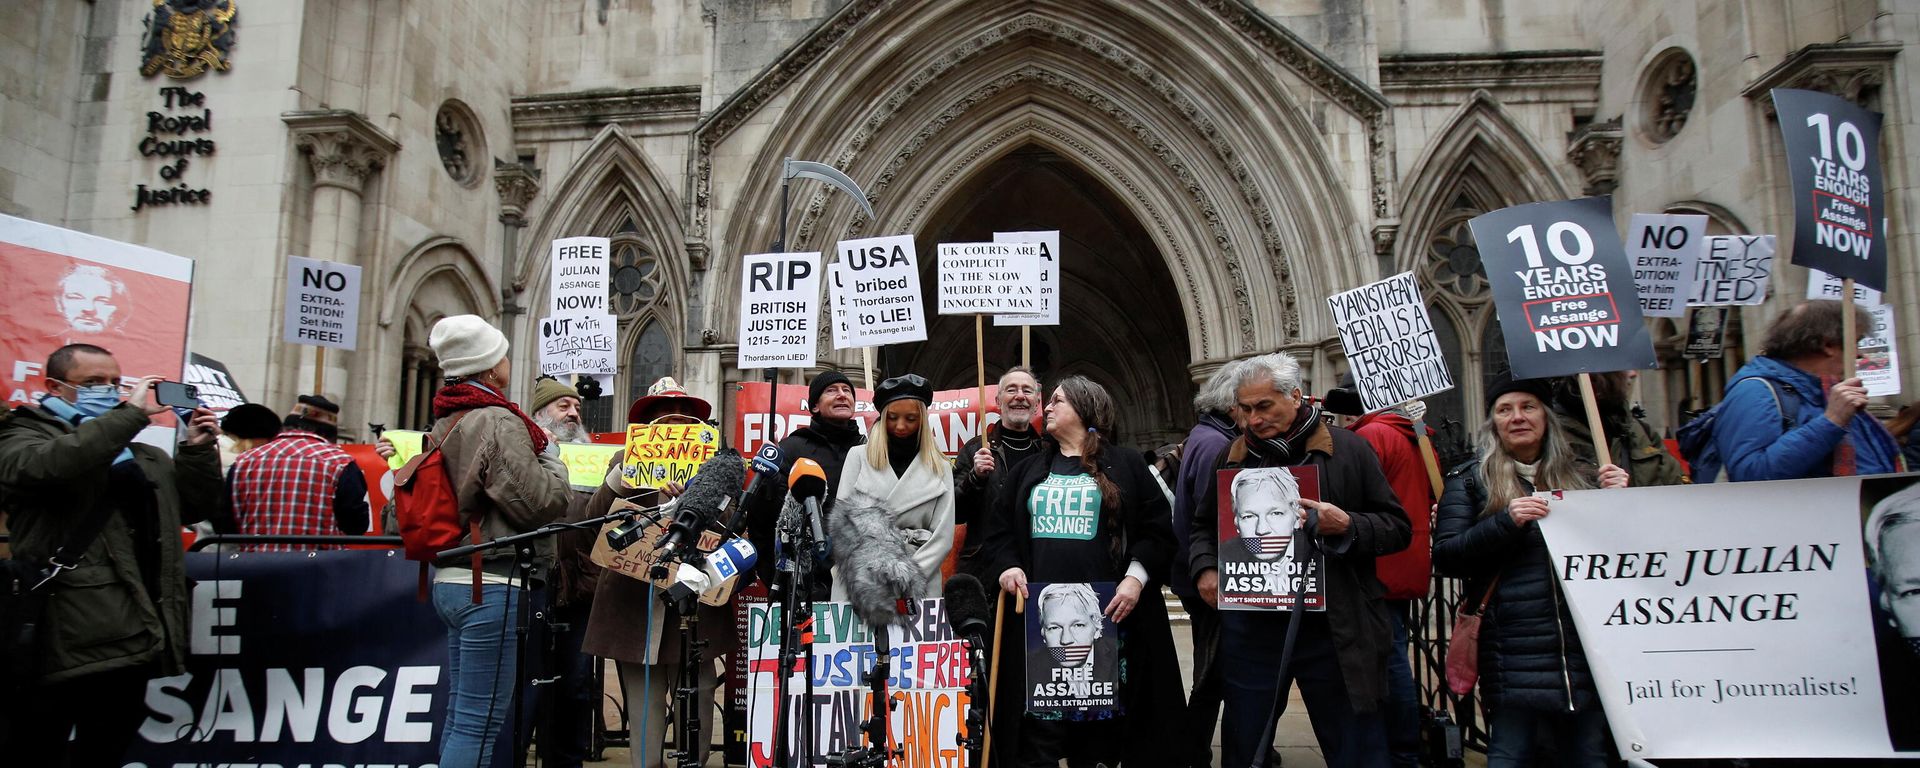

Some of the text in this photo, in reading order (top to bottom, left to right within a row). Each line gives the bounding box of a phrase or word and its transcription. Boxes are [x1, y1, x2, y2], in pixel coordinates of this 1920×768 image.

[160, 88, 205, 108] The
[148, 109, 211, 135] Royal
[138, 138, 215, 156] Courts
[1807, 113, 1866, 172] 10
[160, 159, 188, 181] of
[1811, 157, 1870, 193] YEARS
[131, 184, 211, 212] Justice
[1815, 175, 1869, 206] ENOUGH
[1832, 198, 1856, 215] Free
[1821, 209, 1866, 231] Assange
[1506, 221, 1594, 268] 10
[1642, 226, 1688, 249] NO
[1816, 224, 1871, 260] NOW
[560, 246, 602, 260] FREE
[848, 245, 910, 271] USA
[943, 247, 959, 255] UK
[964, 246, 1010, 255] COURTS
[1014, 246, 1037, 256] ARE
[943, 259, 1006, 268] COMPLICIT
[1637, 256, 1682, 267] EXTRA-
[1694, 258, 1772, 281] ITNESS
[302, 268, 346, 292] NO
[560, 266, 599, 276] JULIAN
[750, 261, 811, 293] RIP
[943, 272, 1020, 281] IN THE SLOW
[1514, 264, 1606, 286] YEARS
[560, 281, 600, 289] ASSANGE
[856, 276, 907, 293] bribed
[943, 285, 993, 294] MURDER
[998, 286, 1013, 294] OF
[1017, 286, 1032, 294] AN
[1523, 281, 1609, 300] ENOUGH
[1654, 285, 1674, 294] him
[301, 294, 345, 307] EXTRA-
[557, 296, 602, 310] NOW!
[853, 295, 914, 307] Thordarson
[943, 298, 1001, 308] INNOCENT
[1007, 298, 1032, 307] MAN
[1329, 274, 1423, 324] MAINSTREAM
[1552, 299, 1588, 313] Free
[300, 305, 344, 319] DITION!
[750, 302, 806, 315] BRITISH
[859, 313, 875, 325] to
[881, 308, 911, 322] LIE!
[1539, 308, 1608, 326] Assange
[299, 316, 343, 329] Set him
[544, 319, 572, 337] OUT
[748, 318, 807, 332] JUSTICE
[869, 327, 899, 335] Assange
[1338, 305, 1431, 355] MEDIA IS A
[298, 328, 344, 343] FREE!
[546, 334, 612, 352] STARMER
[747, 336, 769, 345] 1215
[782, 335, 806, 344] 2021
[1535, 325, 1618, 352] NOW
[566, 350, 582, 358] AND
[787, 353, 808, 361] LIED!
[1348, 330, 1437, 379] TERRORIST
[572, 358, 608, 369] LABOUR
[1358, 358, 1453, 412] ORGANISATION
[630, 426, 696, 441] FREE
[625, 442, 716, 462] ASSANGE
[1031, 486, 1096, 515] FREE
[1226, 562, 1280, 574] HANDS
[1562, 543, 1839, 587] FREE JULIAN
[1604, 593, 1799, 626] ASSANGE
[918, 642, 971, 688] FREE
[1052, 668, 1093, 681] FREE
[1034, 682, 1113, 697] ASSANGE
[1626, 678, 1858, 705] Jail for Journalists!
